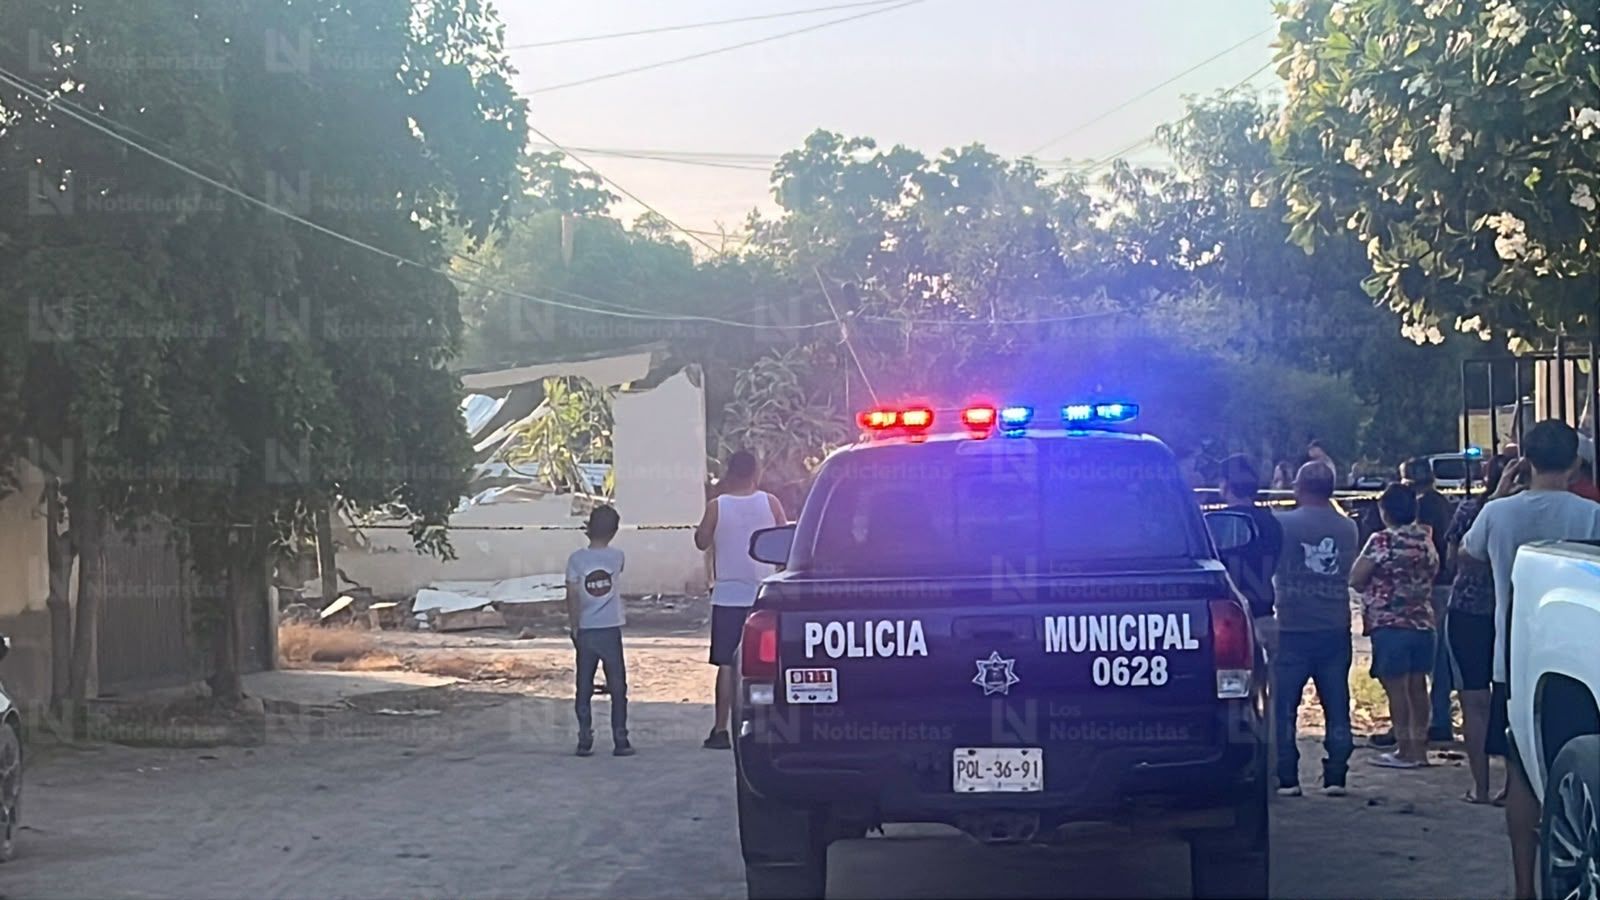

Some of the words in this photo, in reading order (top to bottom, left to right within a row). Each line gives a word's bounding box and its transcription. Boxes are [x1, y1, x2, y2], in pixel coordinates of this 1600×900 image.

[804, 620, 928, 659] POLICIA
[1045, 614, 1199, 653] MUNICIPAL
[1092, 655, 1168, 687] 0628
[956, 760, 1038, 780] POL-36-91
